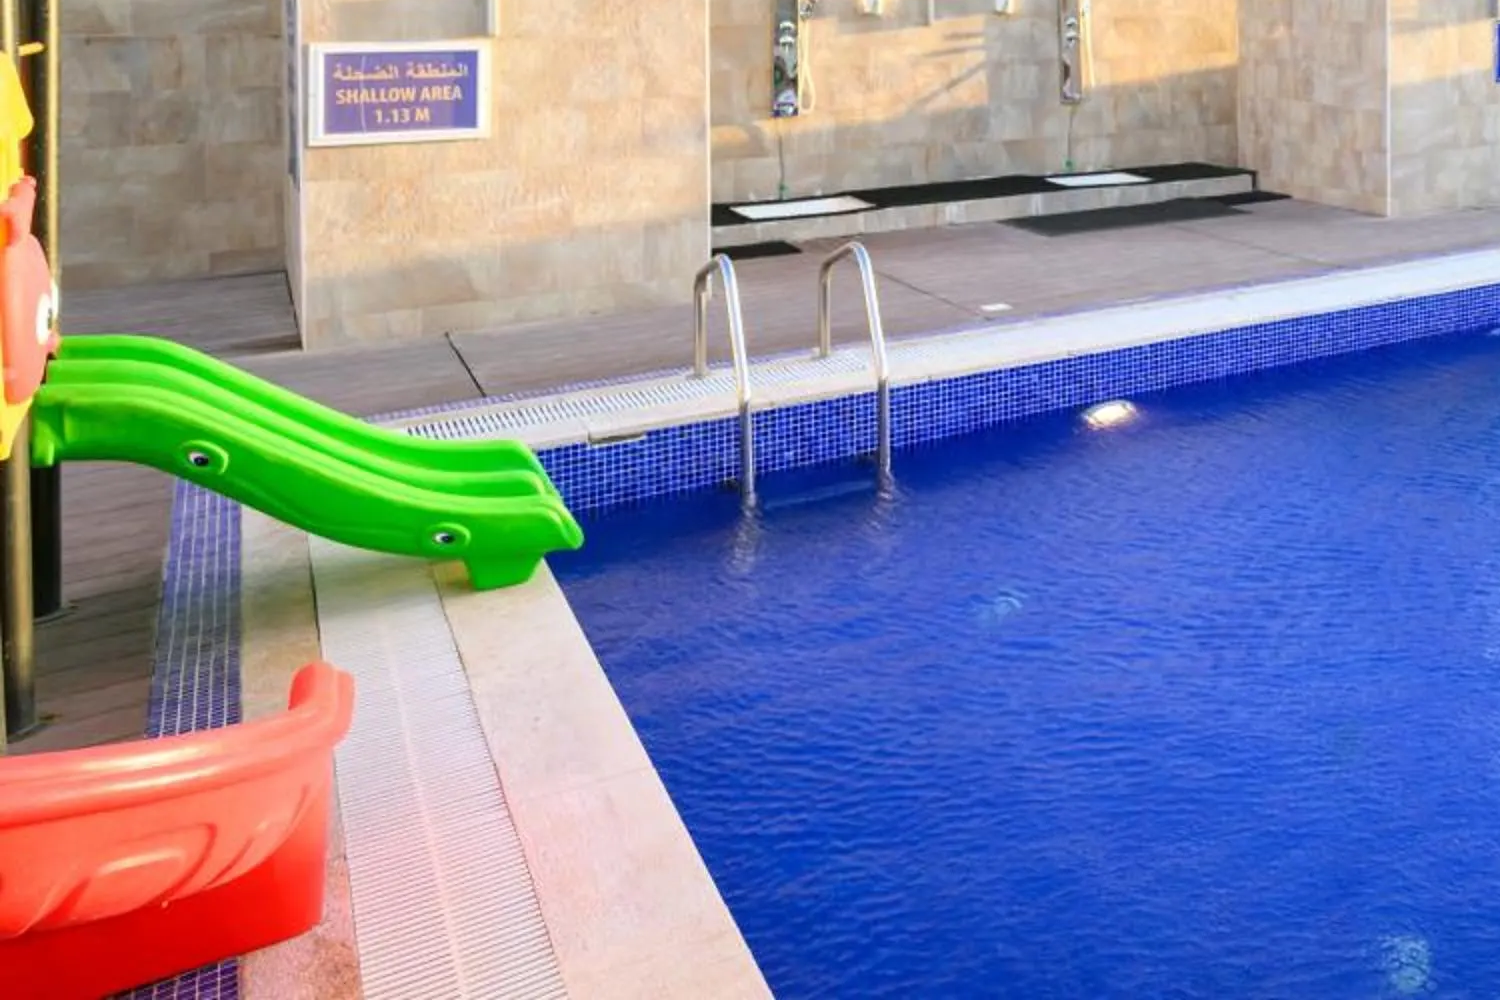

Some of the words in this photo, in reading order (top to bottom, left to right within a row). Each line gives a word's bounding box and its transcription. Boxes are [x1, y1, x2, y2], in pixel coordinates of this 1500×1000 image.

[405, 61, 469, 79] المنطقة
[335, 86, 417, 105] SHALLOW
[419, 84, 463, 101] AREA
[375, 108, 410, 124] 1.13
[415, 106, 431, 122] M
